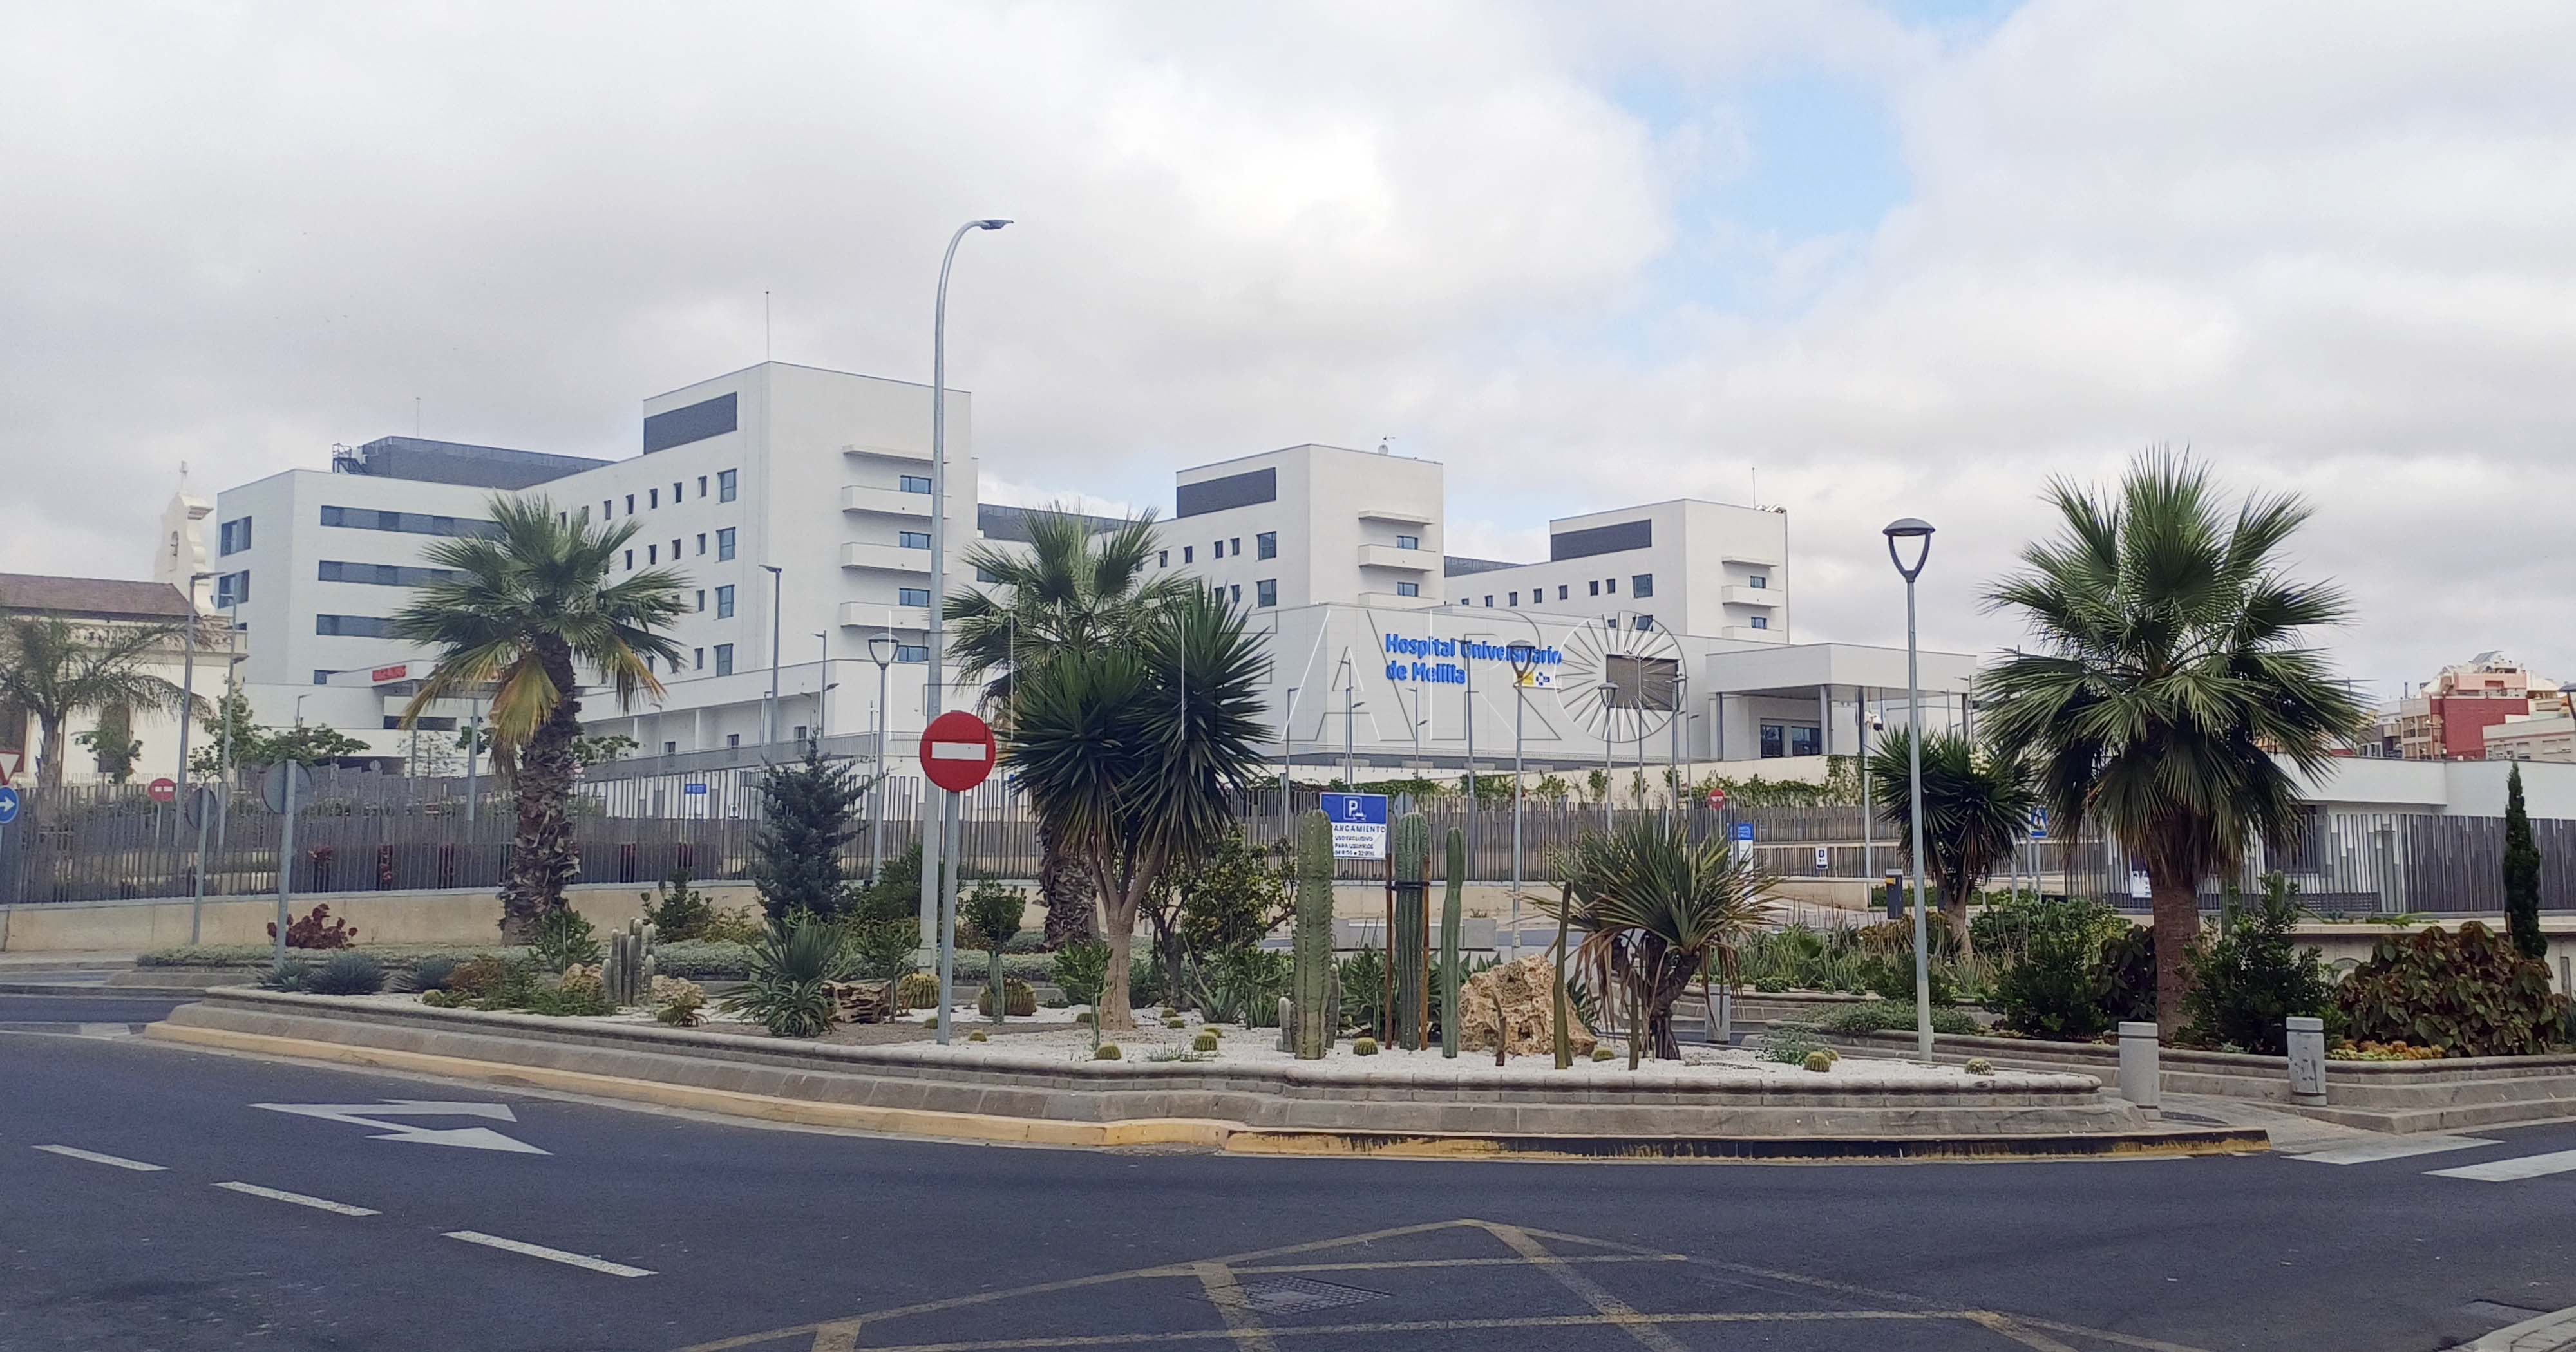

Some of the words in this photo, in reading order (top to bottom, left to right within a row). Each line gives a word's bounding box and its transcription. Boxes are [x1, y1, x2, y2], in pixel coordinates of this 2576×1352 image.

[1385, 632, 1456, 659] Hospital
[1460, 640, 1563, 666] Universitario
[1385, 660, 1408, 681] de
[1411, 662, 1466, 684] Melilla
